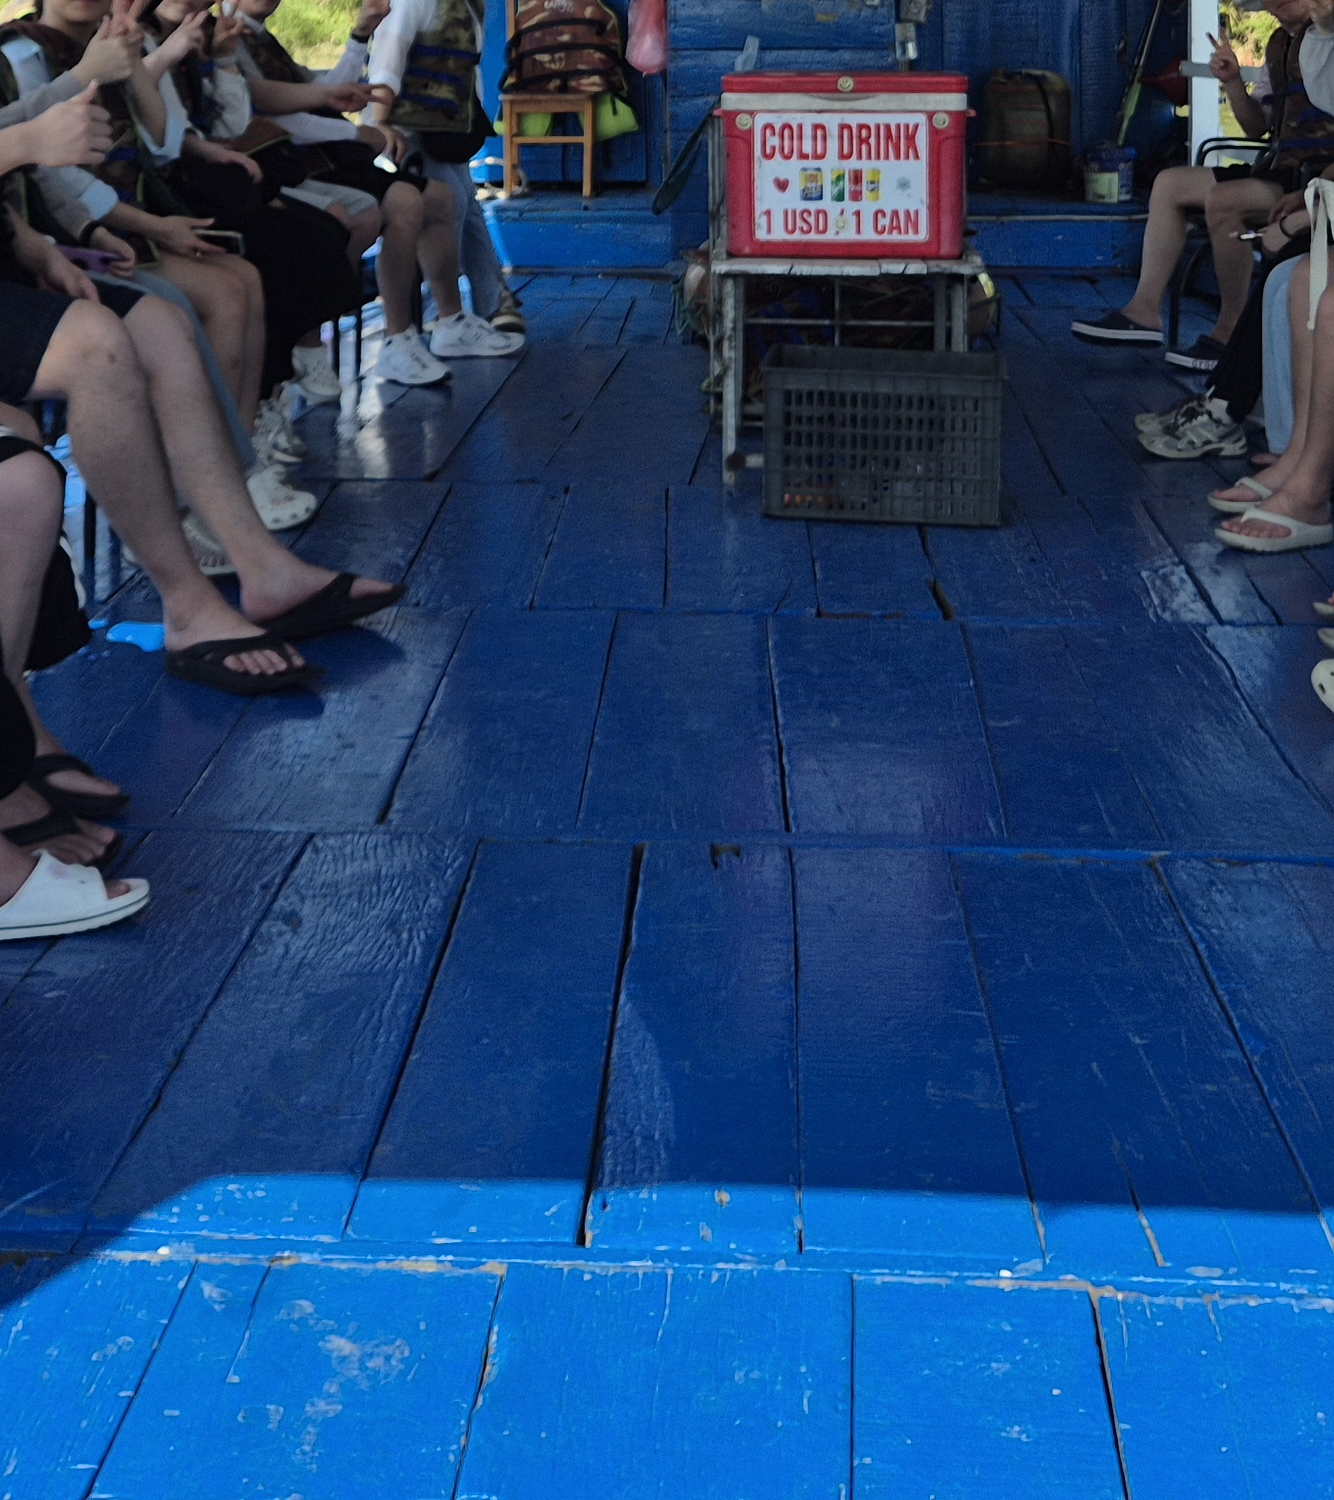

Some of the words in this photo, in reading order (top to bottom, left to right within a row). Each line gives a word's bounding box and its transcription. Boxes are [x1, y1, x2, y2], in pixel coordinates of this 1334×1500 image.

[760, 122, 828, 161] COLD
[837, 122, 921, 161] DRINK
[762, 208, 773, 235] 1
[783, 208, 828, 235] USD
[853, 208, 862, 235] 1
[872, 208, 919, 235] CAN
